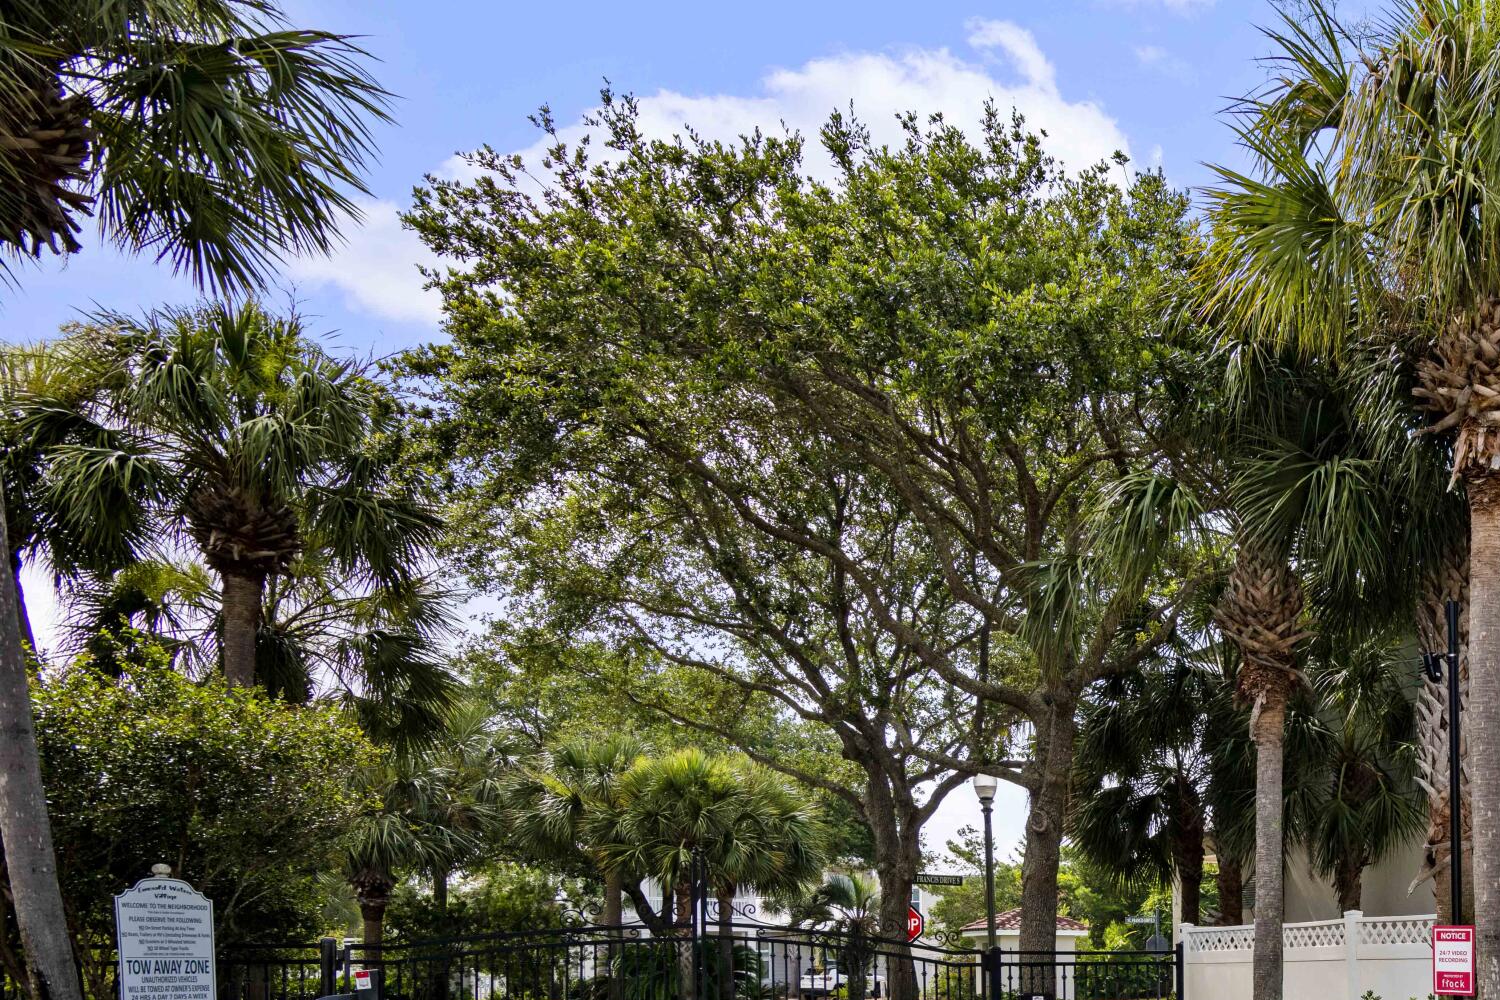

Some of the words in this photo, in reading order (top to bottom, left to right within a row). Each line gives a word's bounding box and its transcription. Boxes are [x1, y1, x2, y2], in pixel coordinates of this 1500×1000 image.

[916, 876, 939, 884] FRANCIS
[940, 876, 956, 884] DRIVE
[126, 960, 151, 974] TOW
[154, 960, 182, 974] AWAY
[185, 960, 210, 974] ZONE
